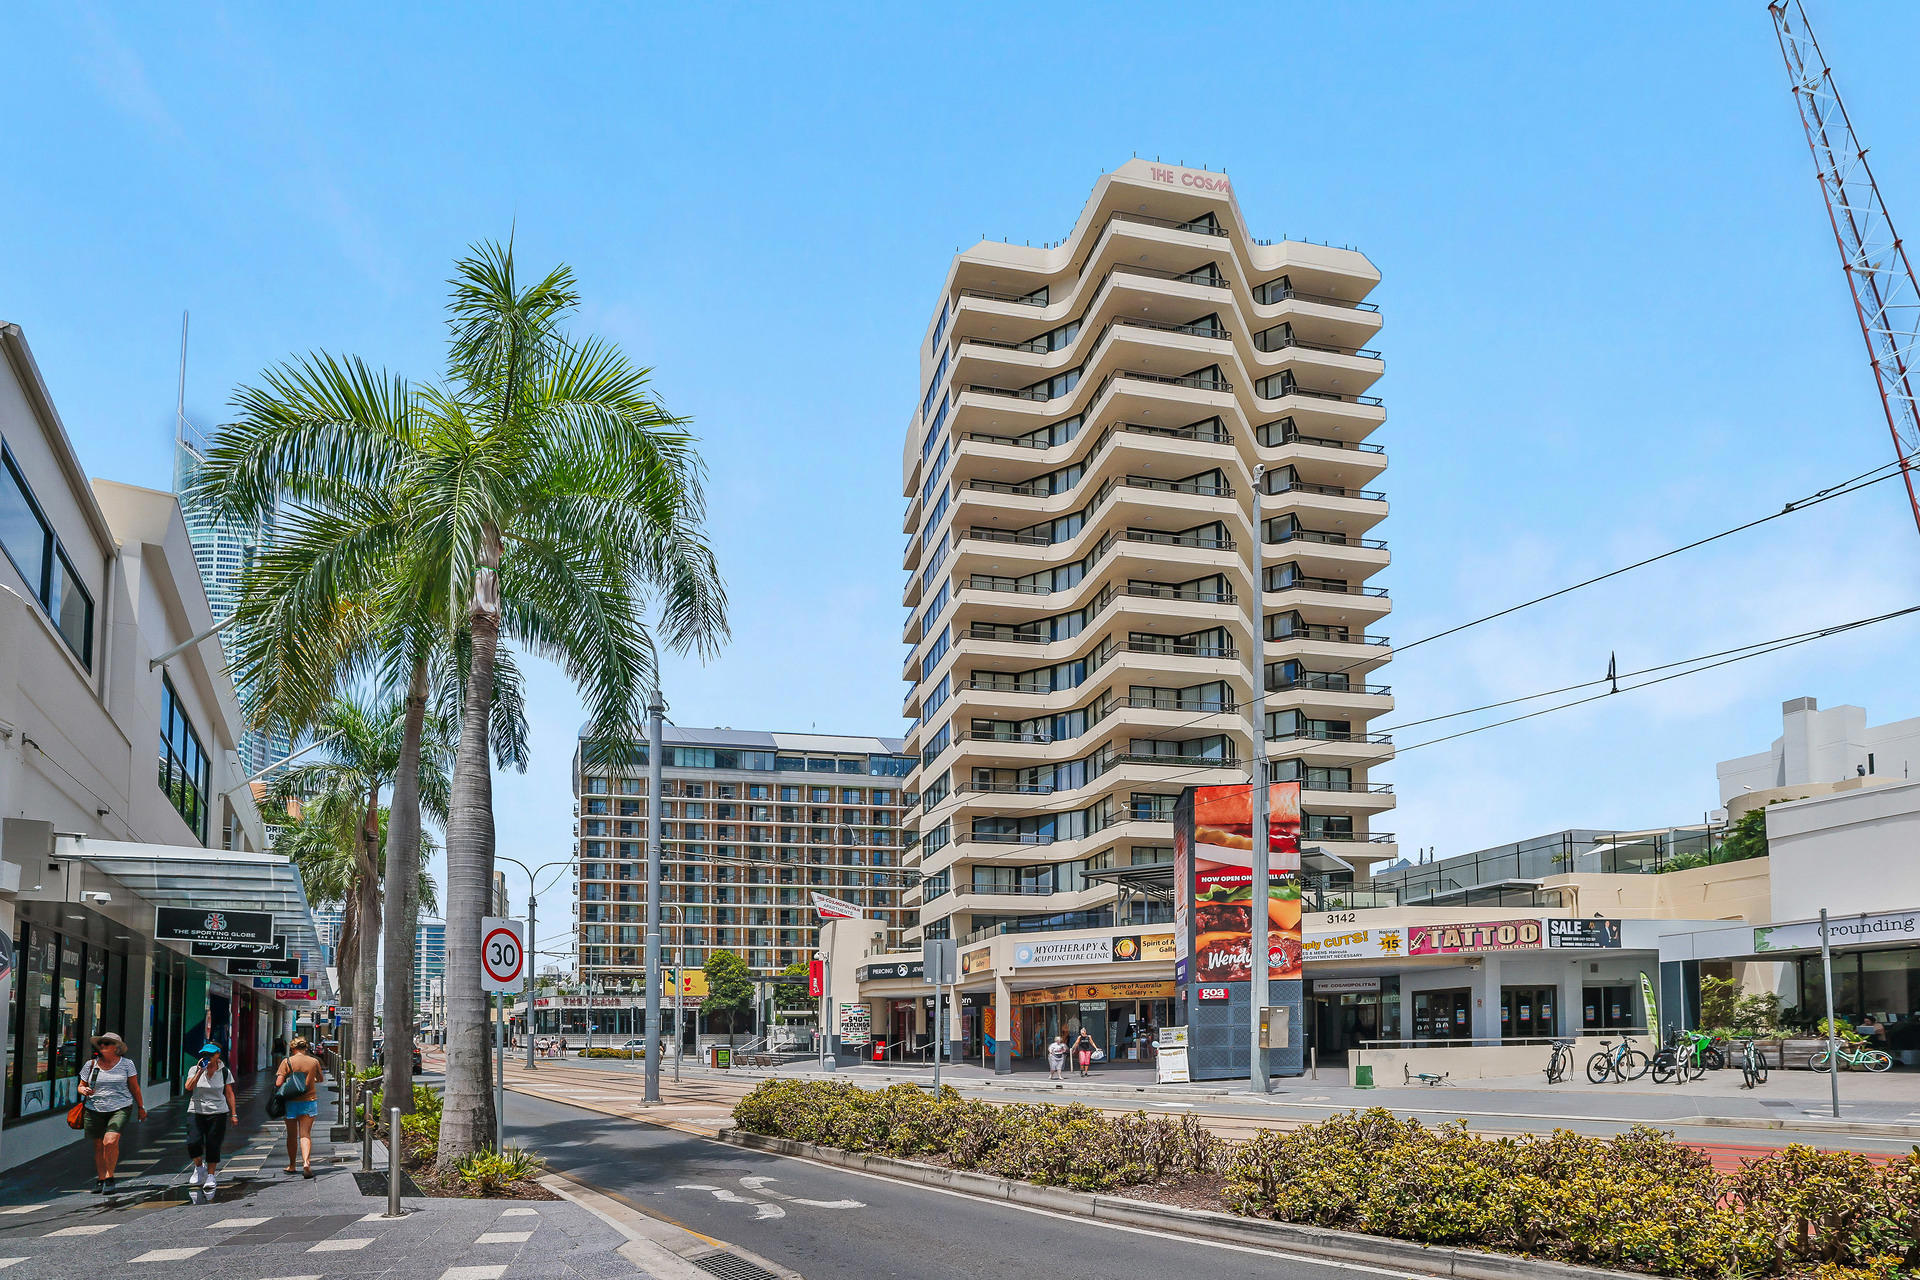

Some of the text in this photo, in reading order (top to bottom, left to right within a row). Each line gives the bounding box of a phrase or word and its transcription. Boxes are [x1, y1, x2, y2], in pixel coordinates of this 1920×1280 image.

[1151, 167, 1174, 184] THE
[823, 903, 853, 915] APARTMENTS
[1327, 913, 1355, 924] 3142
[191, 929, 229, 937] SPORTING
[1550, 920, 1582, 935] SALE
[1324, 931, 1369, 948] CUTS!
[1426, 923, 1540, 949] TATTOO
[1034, 942, 1109, 954] MYOTHERAPY &
[1142, 940, 1161, 948] Spirit
[491, 943, 515, 967] 30
[1033, 952, 1110, 963] ACUPUNCTURE CLINIC
[1111, 983, 1127, 991] Spirit
[1202, 988, 1225, 999] goa
